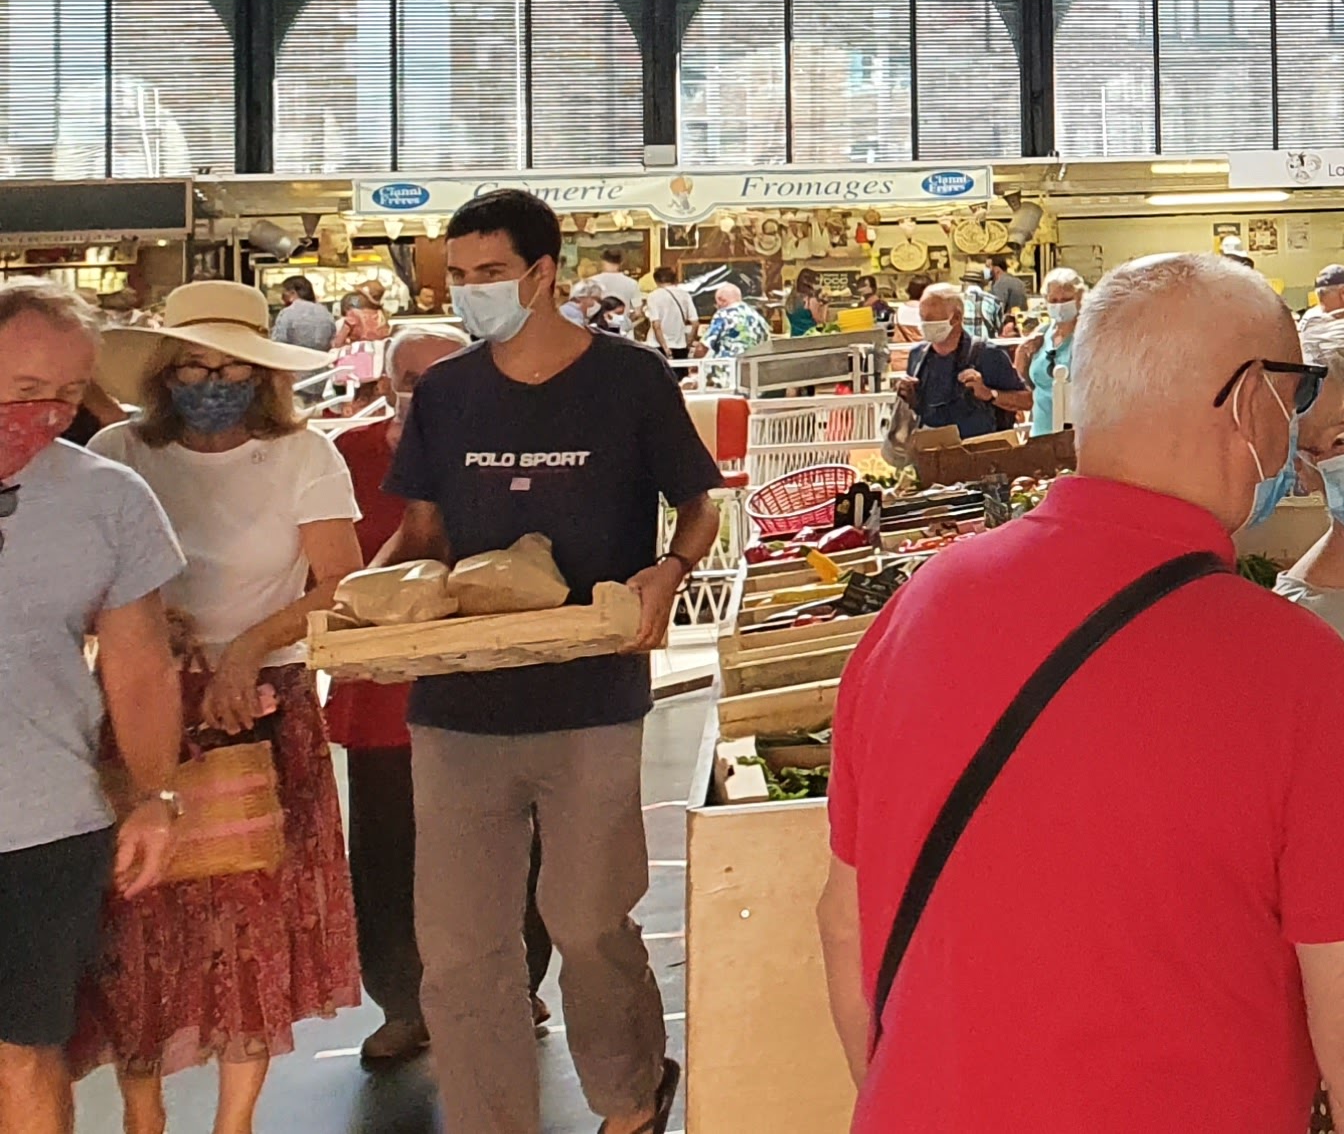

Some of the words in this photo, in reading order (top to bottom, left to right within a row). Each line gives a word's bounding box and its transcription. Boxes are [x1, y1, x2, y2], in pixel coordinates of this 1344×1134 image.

[740, 176, 894, 199] Fromages
[465, 452, 515, 467] POLO
[519, 451, 591, 467] SPORT
